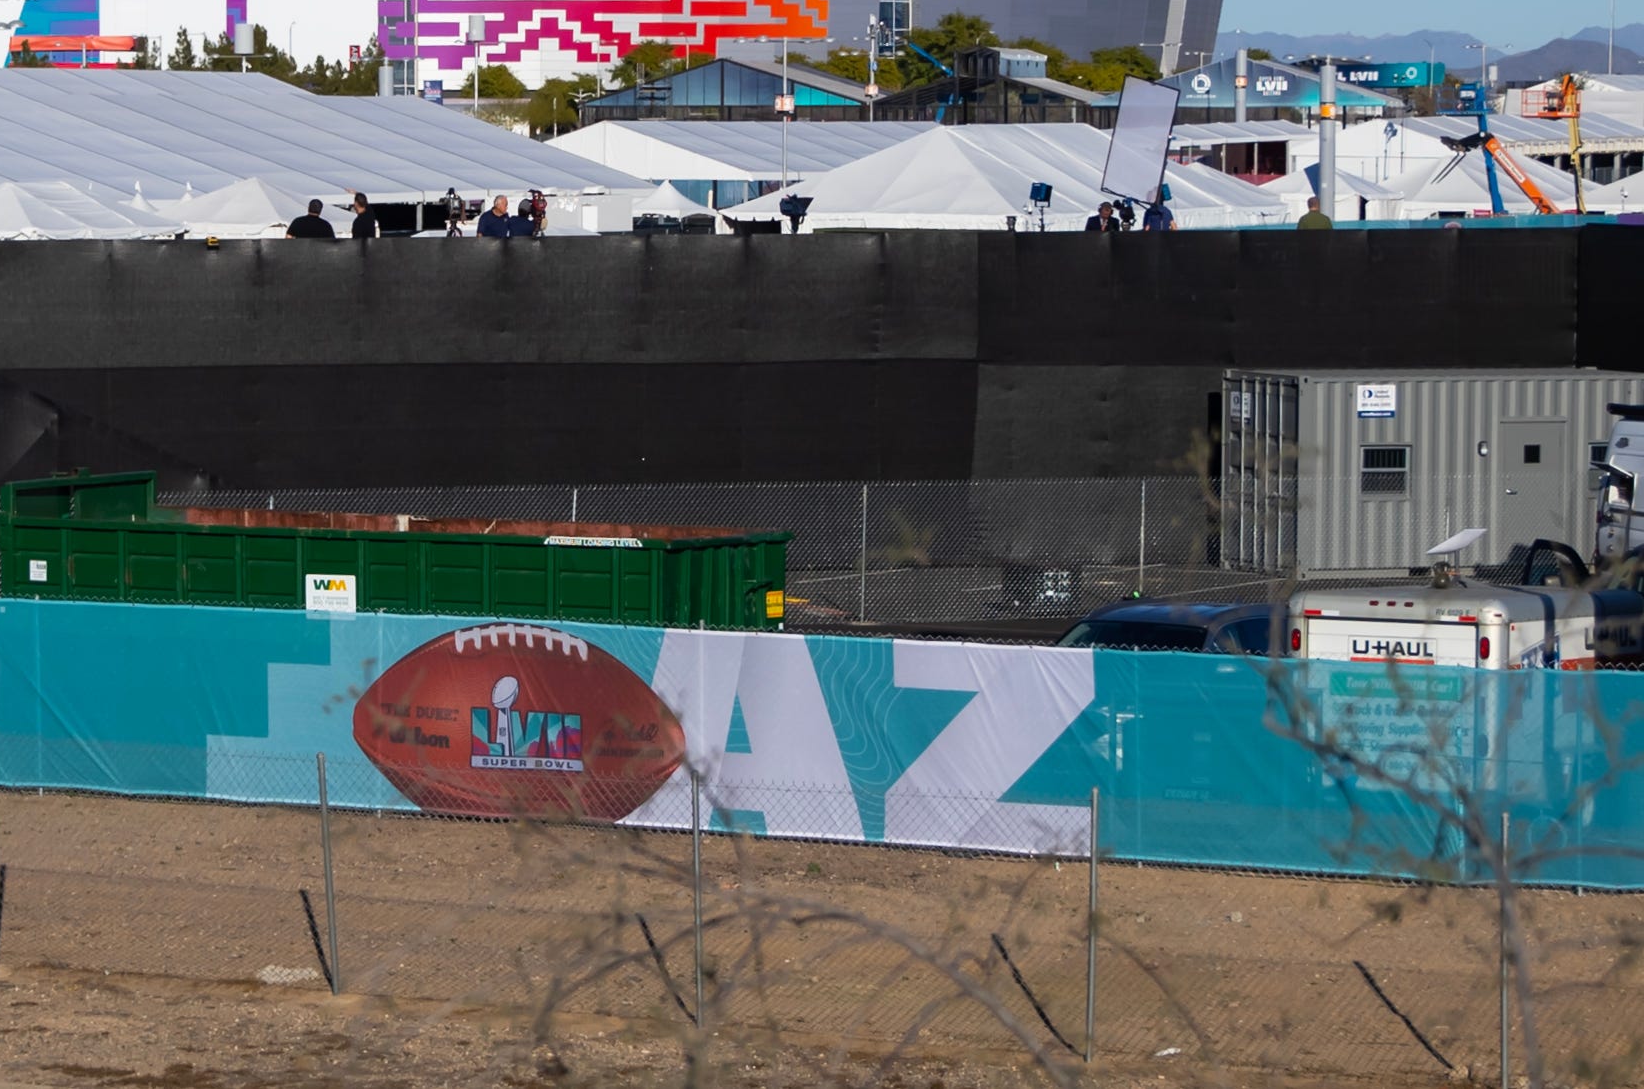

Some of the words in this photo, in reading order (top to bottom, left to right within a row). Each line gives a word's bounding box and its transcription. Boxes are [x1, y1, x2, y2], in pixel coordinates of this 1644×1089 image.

[1349, 70, 1380, 82] LVII
[1256, 80, 1289, 92] LVII
[313, 578, 347, 592] WM
[1352, 639, 1434, 657] U-HAUL
[471, 706, 582, 760] LVII
[614, 627, 1096, 859] AZ
[481, 757, 528, 768] SUPER
[534, 758, 575, 770] BOWL
